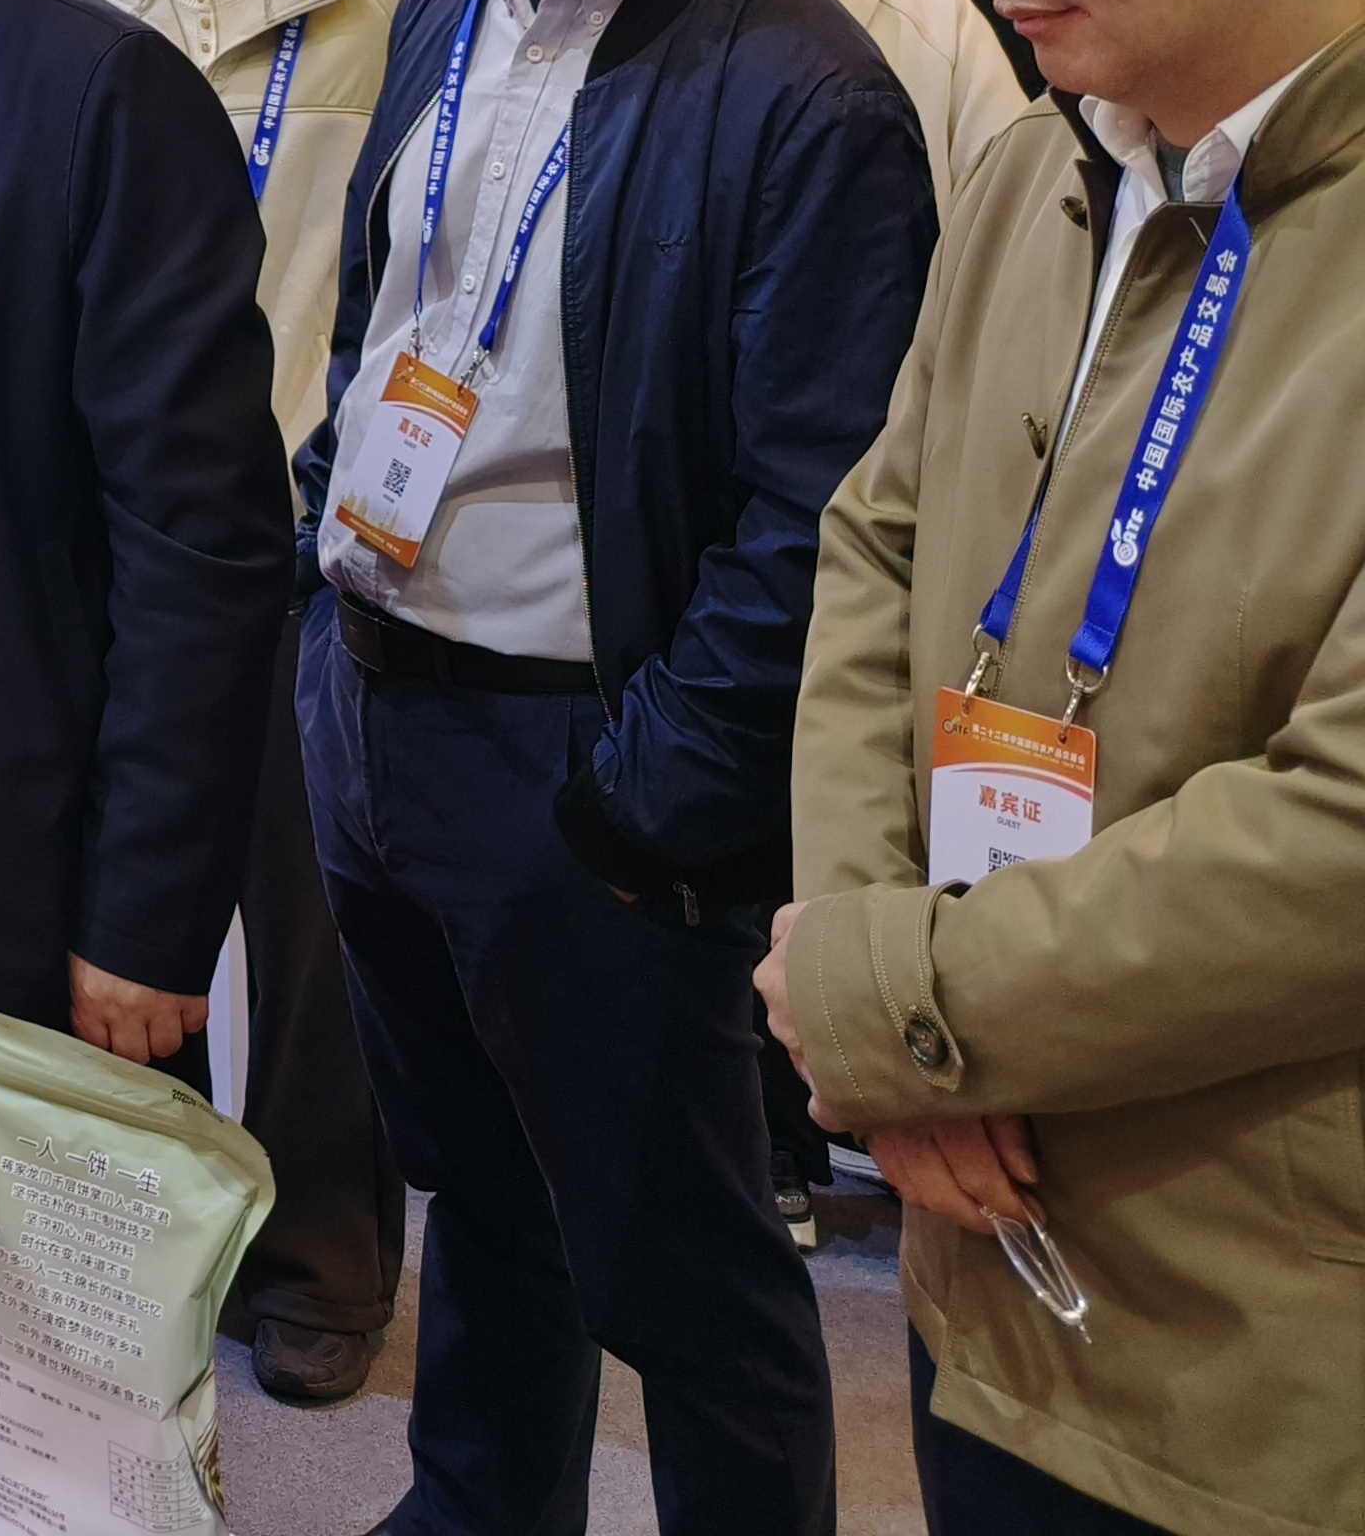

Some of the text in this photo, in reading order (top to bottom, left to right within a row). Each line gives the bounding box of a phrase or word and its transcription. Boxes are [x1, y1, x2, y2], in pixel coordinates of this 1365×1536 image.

[1135, 249, 1239, 492] 中国国际农产品交易会
[397, 416, 434, 449] 嘉宾证
[978, 784, 1042, 824] 嘉宾证
[996, 817, 1021, 830] GUEST
[18, 1136, 160, 1196] 一人 一饼 一生
